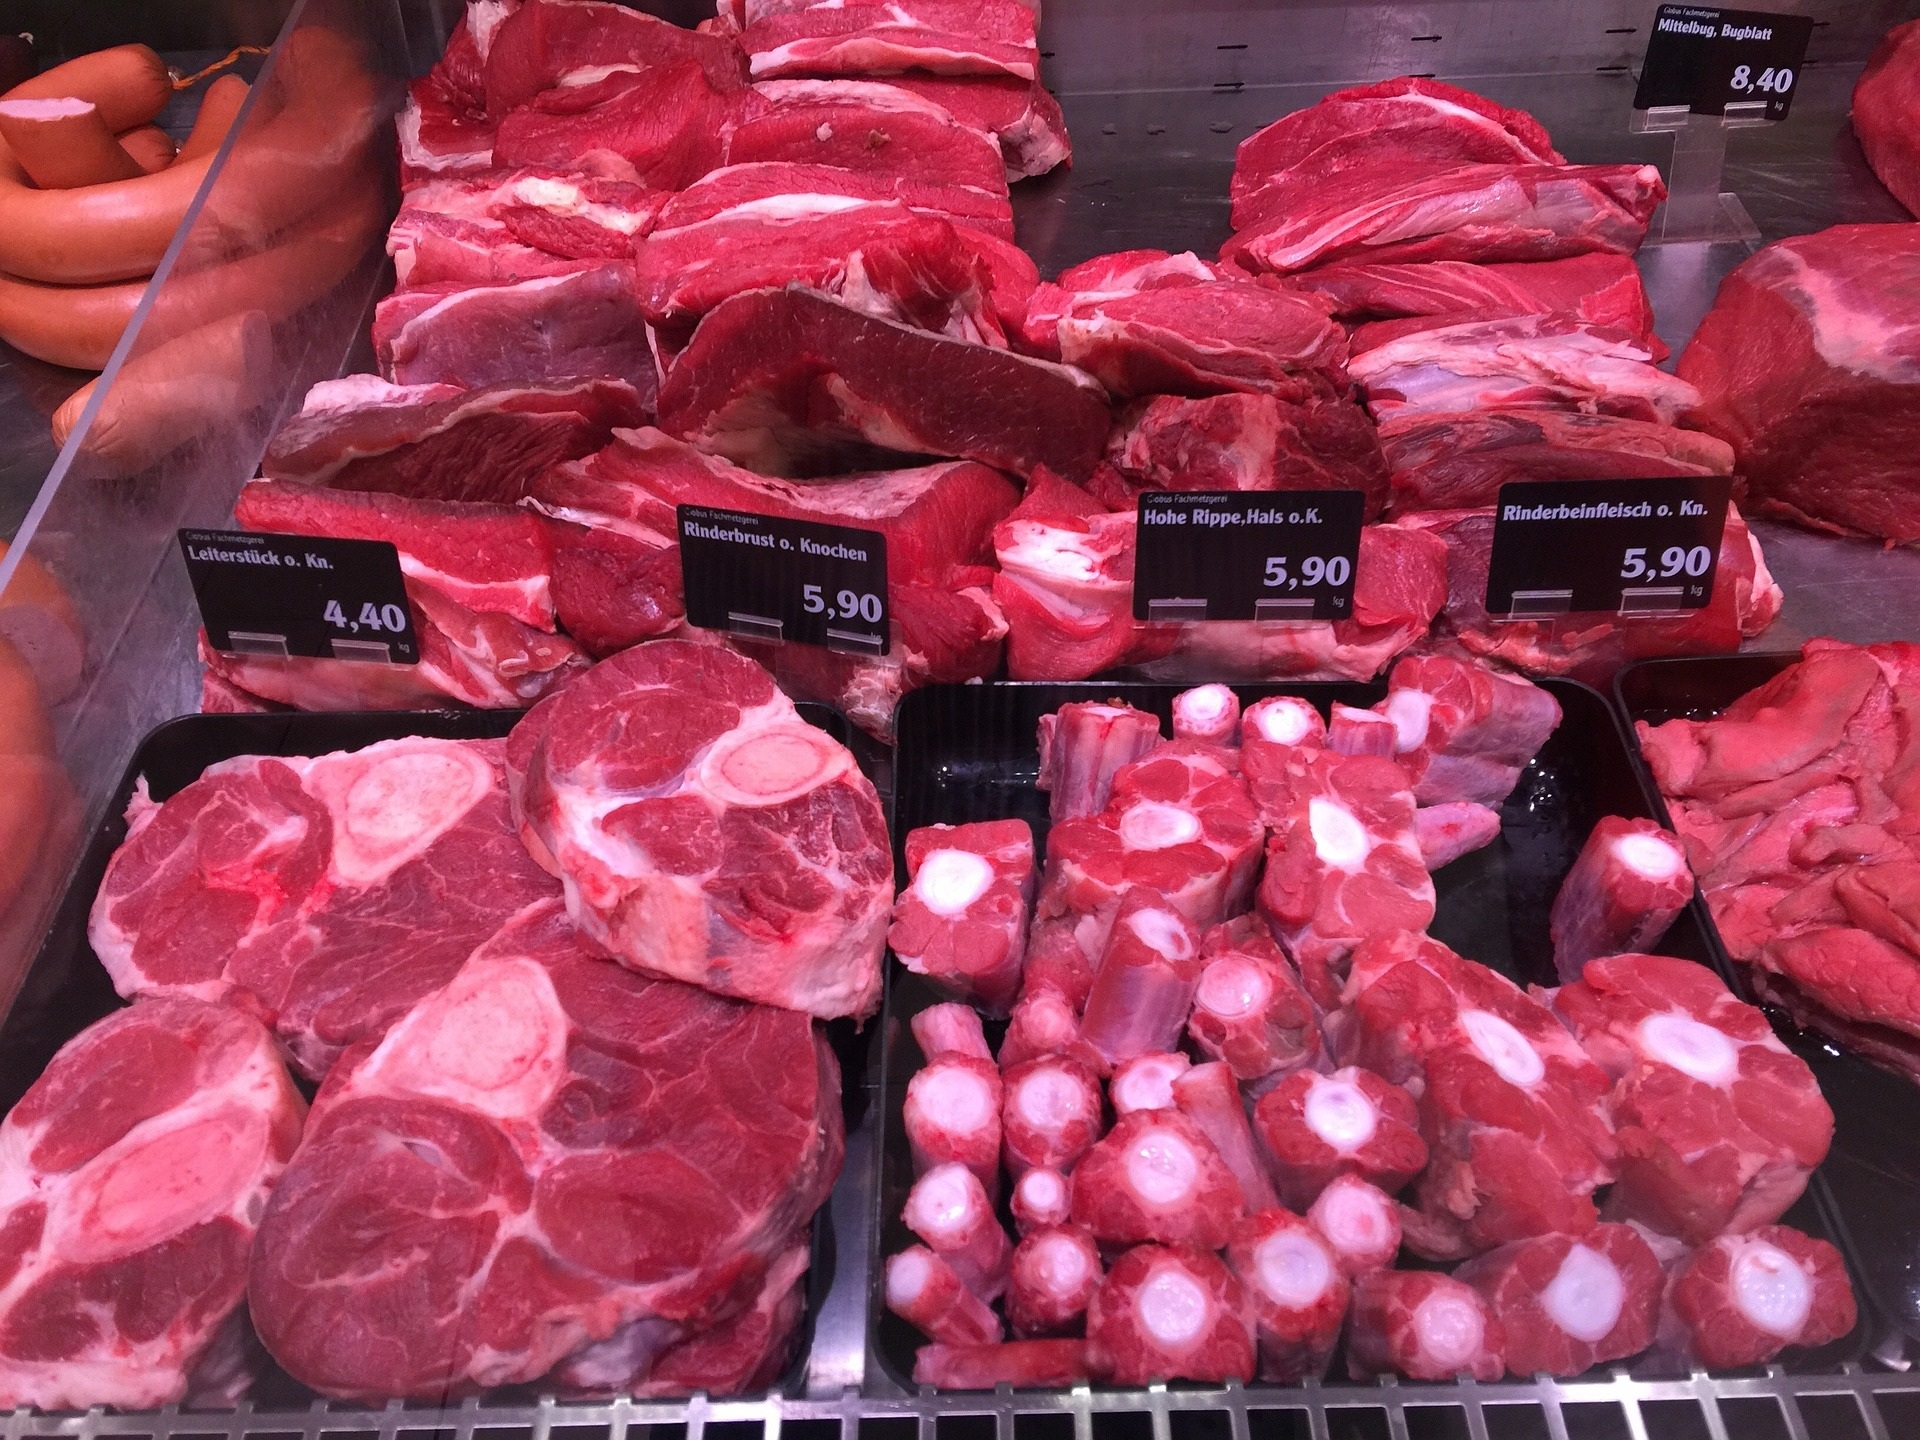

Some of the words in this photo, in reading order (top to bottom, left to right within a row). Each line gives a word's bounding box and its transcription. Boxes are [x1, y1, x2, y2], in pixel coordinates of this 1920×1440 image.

[1658, 18, 1717, 38] Mittelbug,
[1721, 23, 1773, 41] Bugblatt
[1730, 65, 1793, 95] 8,40
[1144, 508, 1187, 525] Hohe
[1192, 508, 1284, 528] Rippe,Hals
[1288, 508, 1323, 525] o.K.
[1502, 501, 1652, 521] Rinderbeinfleisch
[1657, 504, 1673, 517] o.
[1679, 499, 1708, 516] Kn.
[684, 520, 775, 548] Rinderbrust
[779, 538, 795, 551] o.
[800, 537, 867, 562] Knochen
[188, 545, 281, 567] Leiterstück
[284, 556, 301, 567] o.
[305, 552, 334, 570] Kn.
[1620, 545, 1711, 583] 5,90
[1263, 556, 1350, 591] 5,90
[803, 584, 883, 623] 5,90
[1332, 596, 1344, 608] kg
[1690, 585, 1703, 597] kg
[323, 600, 406, 633] 4,40
[397, 641, 410, 654] kg
